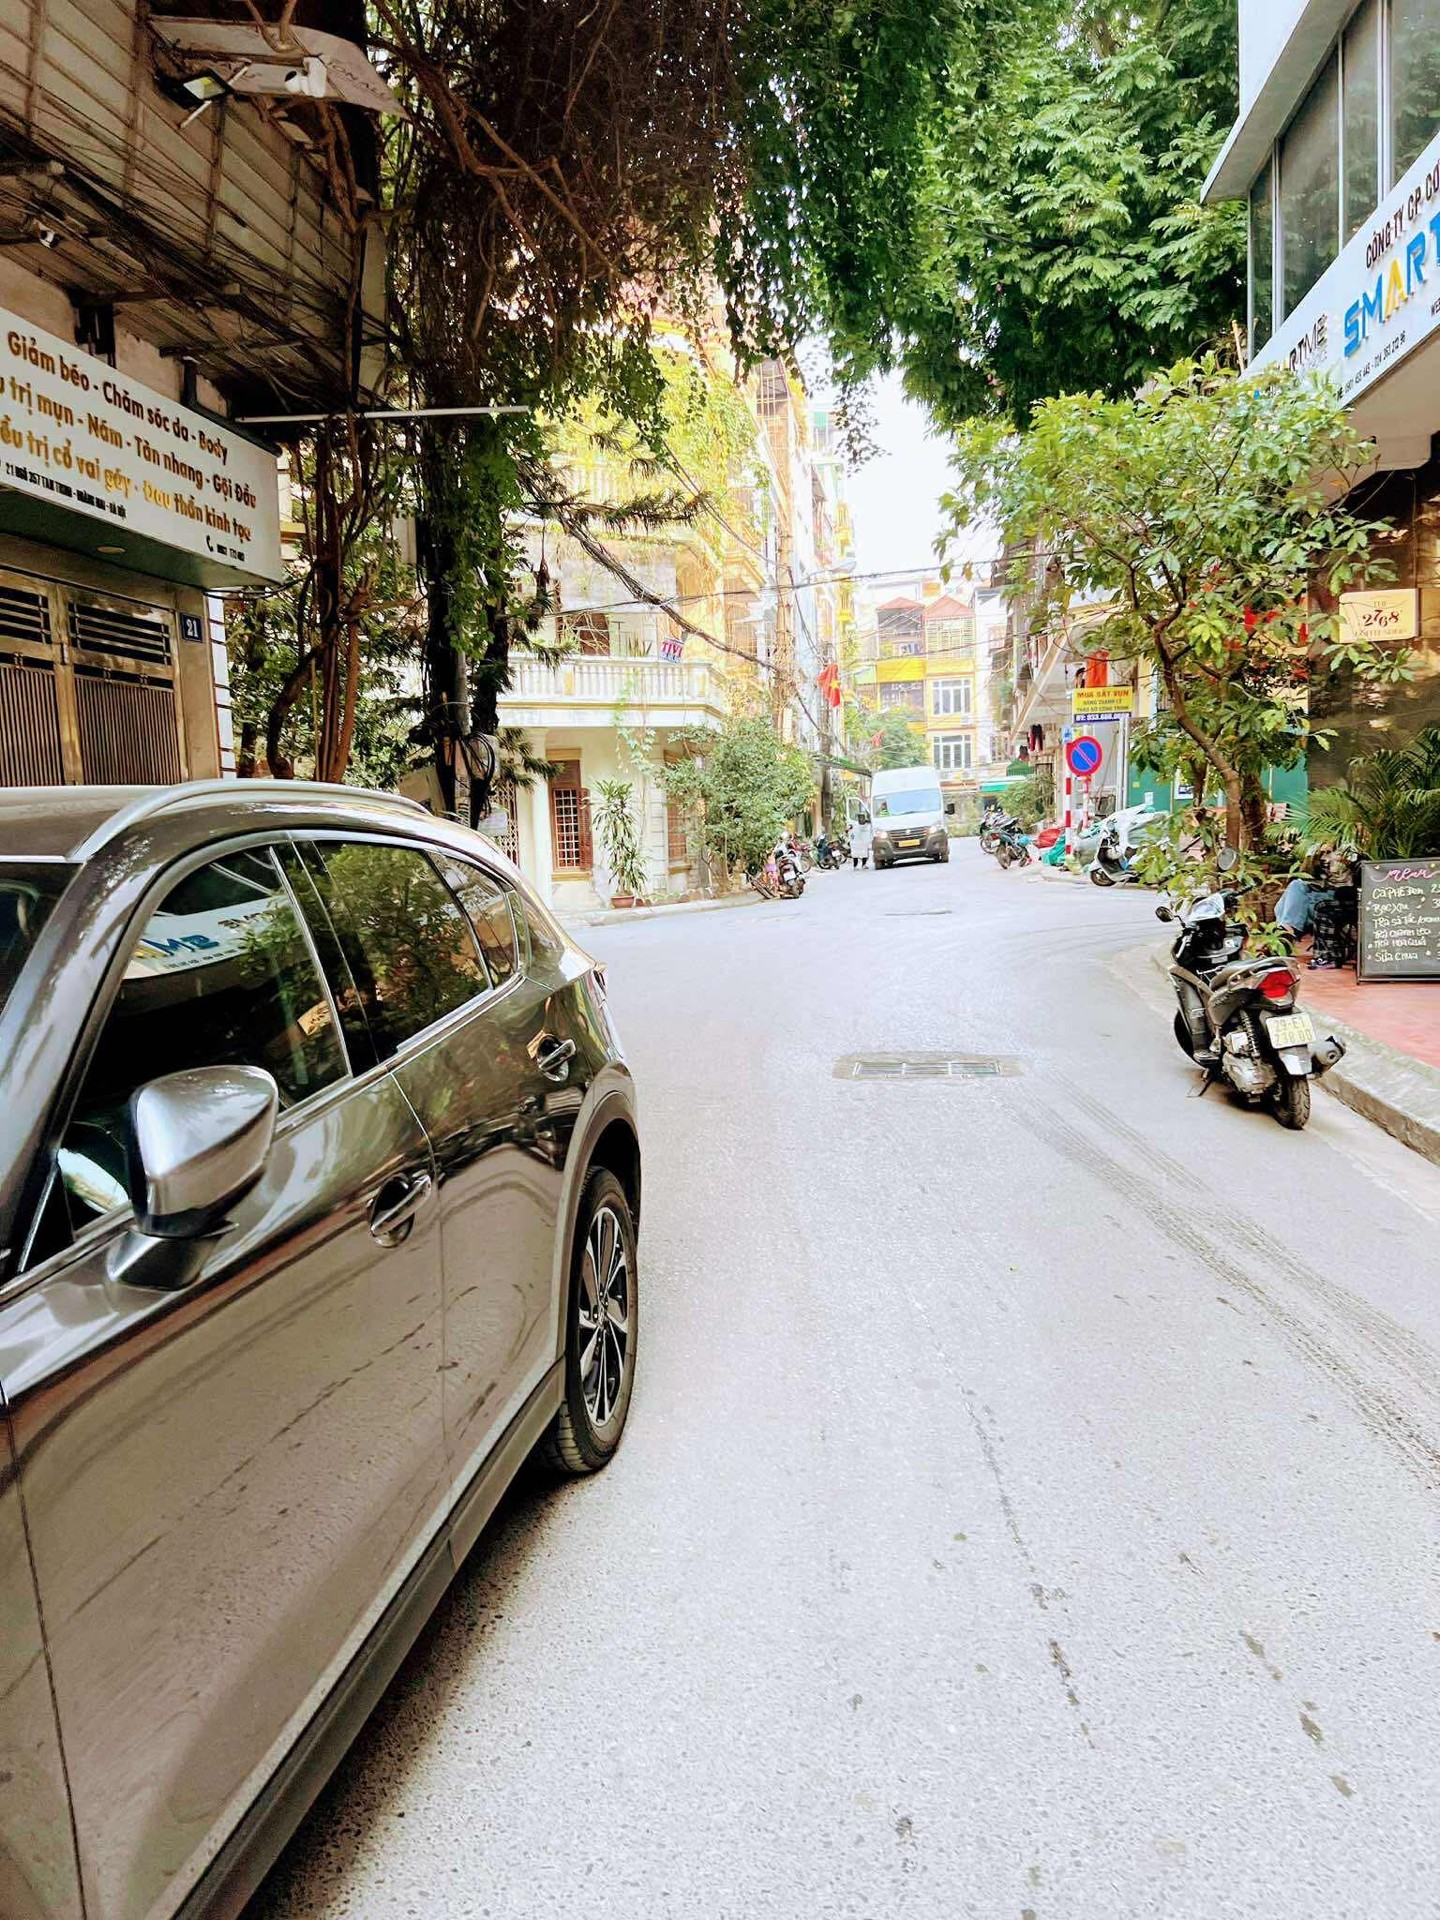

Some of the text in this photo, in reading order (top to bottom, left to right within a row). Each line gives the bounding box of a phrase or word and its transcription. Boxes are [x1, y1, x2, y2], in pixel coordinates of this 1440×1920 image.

[1366, 221, 1391, 269] CÔNG
[1393, 204, 1405, 238] TY
[7, 330, 55, 375] Giảm
[60, 354, 90, 392] béo
[147, 408, 170, 432] sóc
[198, 430, 228, 465] Body
[37, 393, 74, 428] mụn
[87, 412, 123, 449] Nám
[133, 434, 161, 466] Tàn
[163, 450, 204, 490] nhang
[212, 473, 233, 502] Gội
[76, 457, 101, 482] vai
[205, 504, 231, 534] kinh
[186, 618, 199, 638] 21
[662, 640, 683, 658] TIVI
